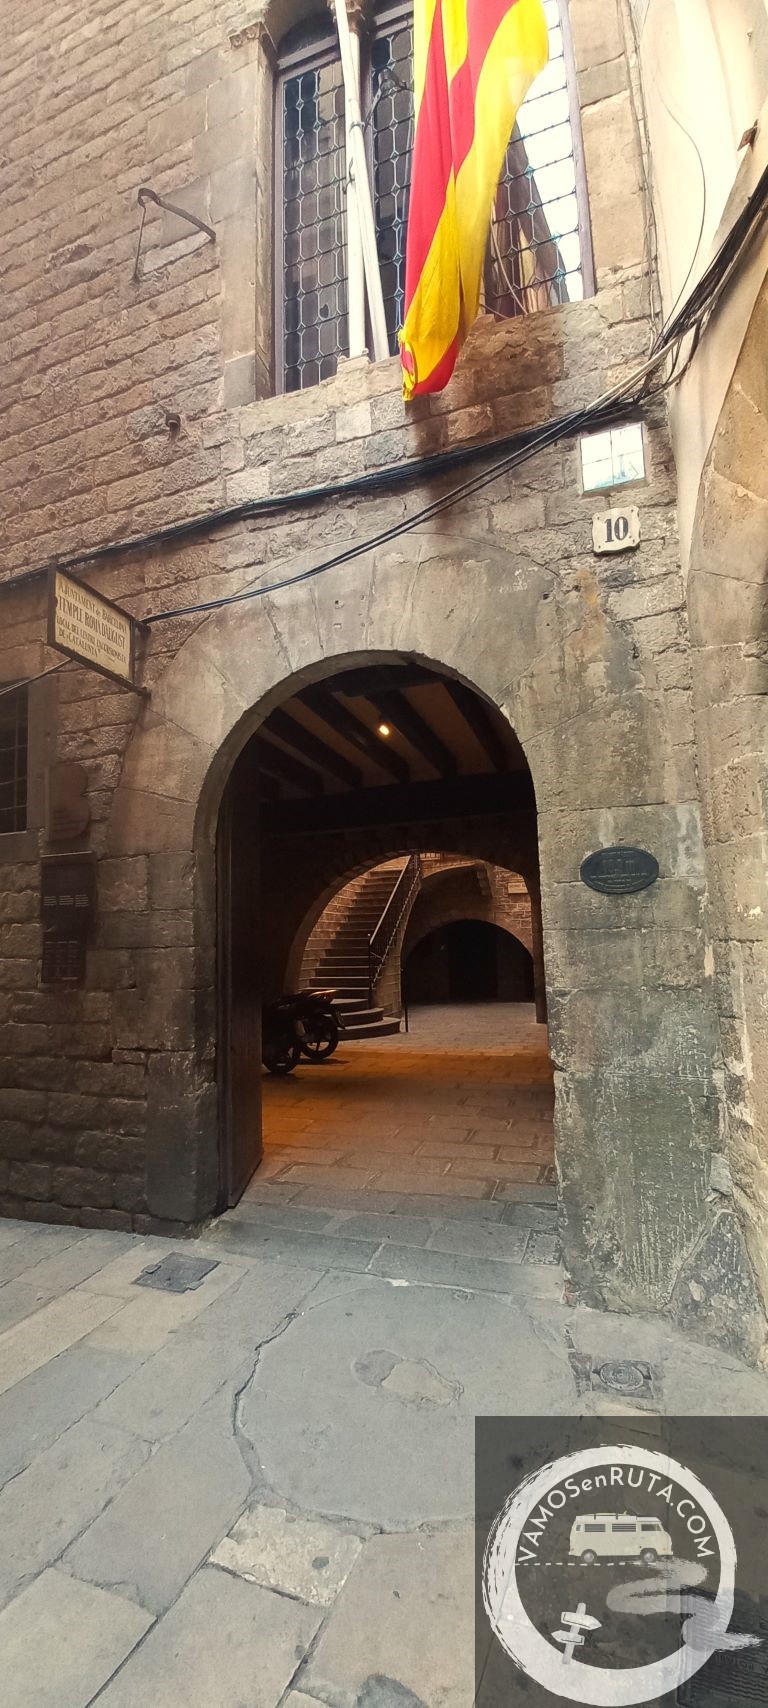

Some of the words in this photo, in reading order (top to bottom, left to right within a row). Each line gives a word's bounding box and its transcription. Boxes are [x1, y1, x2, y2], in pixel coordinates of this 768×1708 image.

[604, 516, 629, 543] 10
[58, 580, 95, 614] AJUNTAMENT
[102, 608, 127, 633] BARCELONA
[59, 595, 83, 623] TEMPLE
